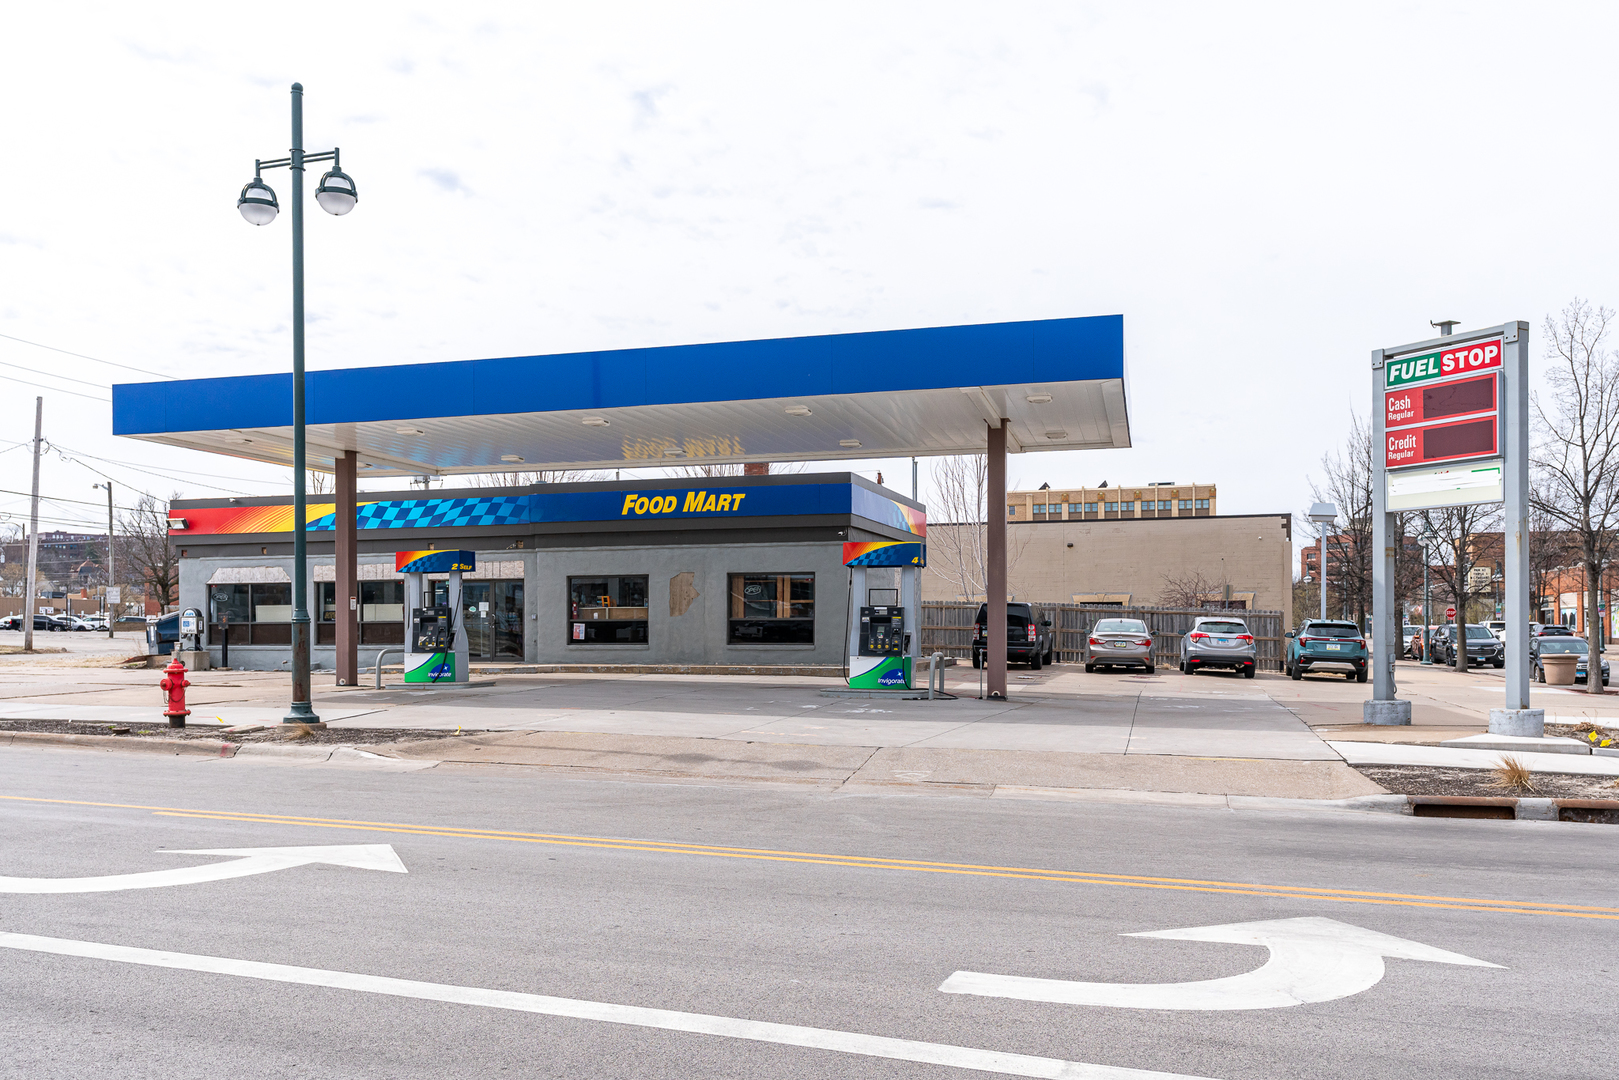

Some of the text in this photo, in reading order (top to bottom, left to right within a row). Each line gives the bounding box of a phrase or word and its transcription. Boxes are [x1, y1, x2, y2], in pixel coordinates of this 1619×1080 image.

[1389, 345, 1498, 382] FUEL STOP
[1388, 395, 1411, 412] Cash
[1388, 410, 1414, 421] Regular
[1388, 434, 1417, 451] Credit
[1388, 450, 1414, 461] Regular
[621, 491, 746, 515] FOOD MART
